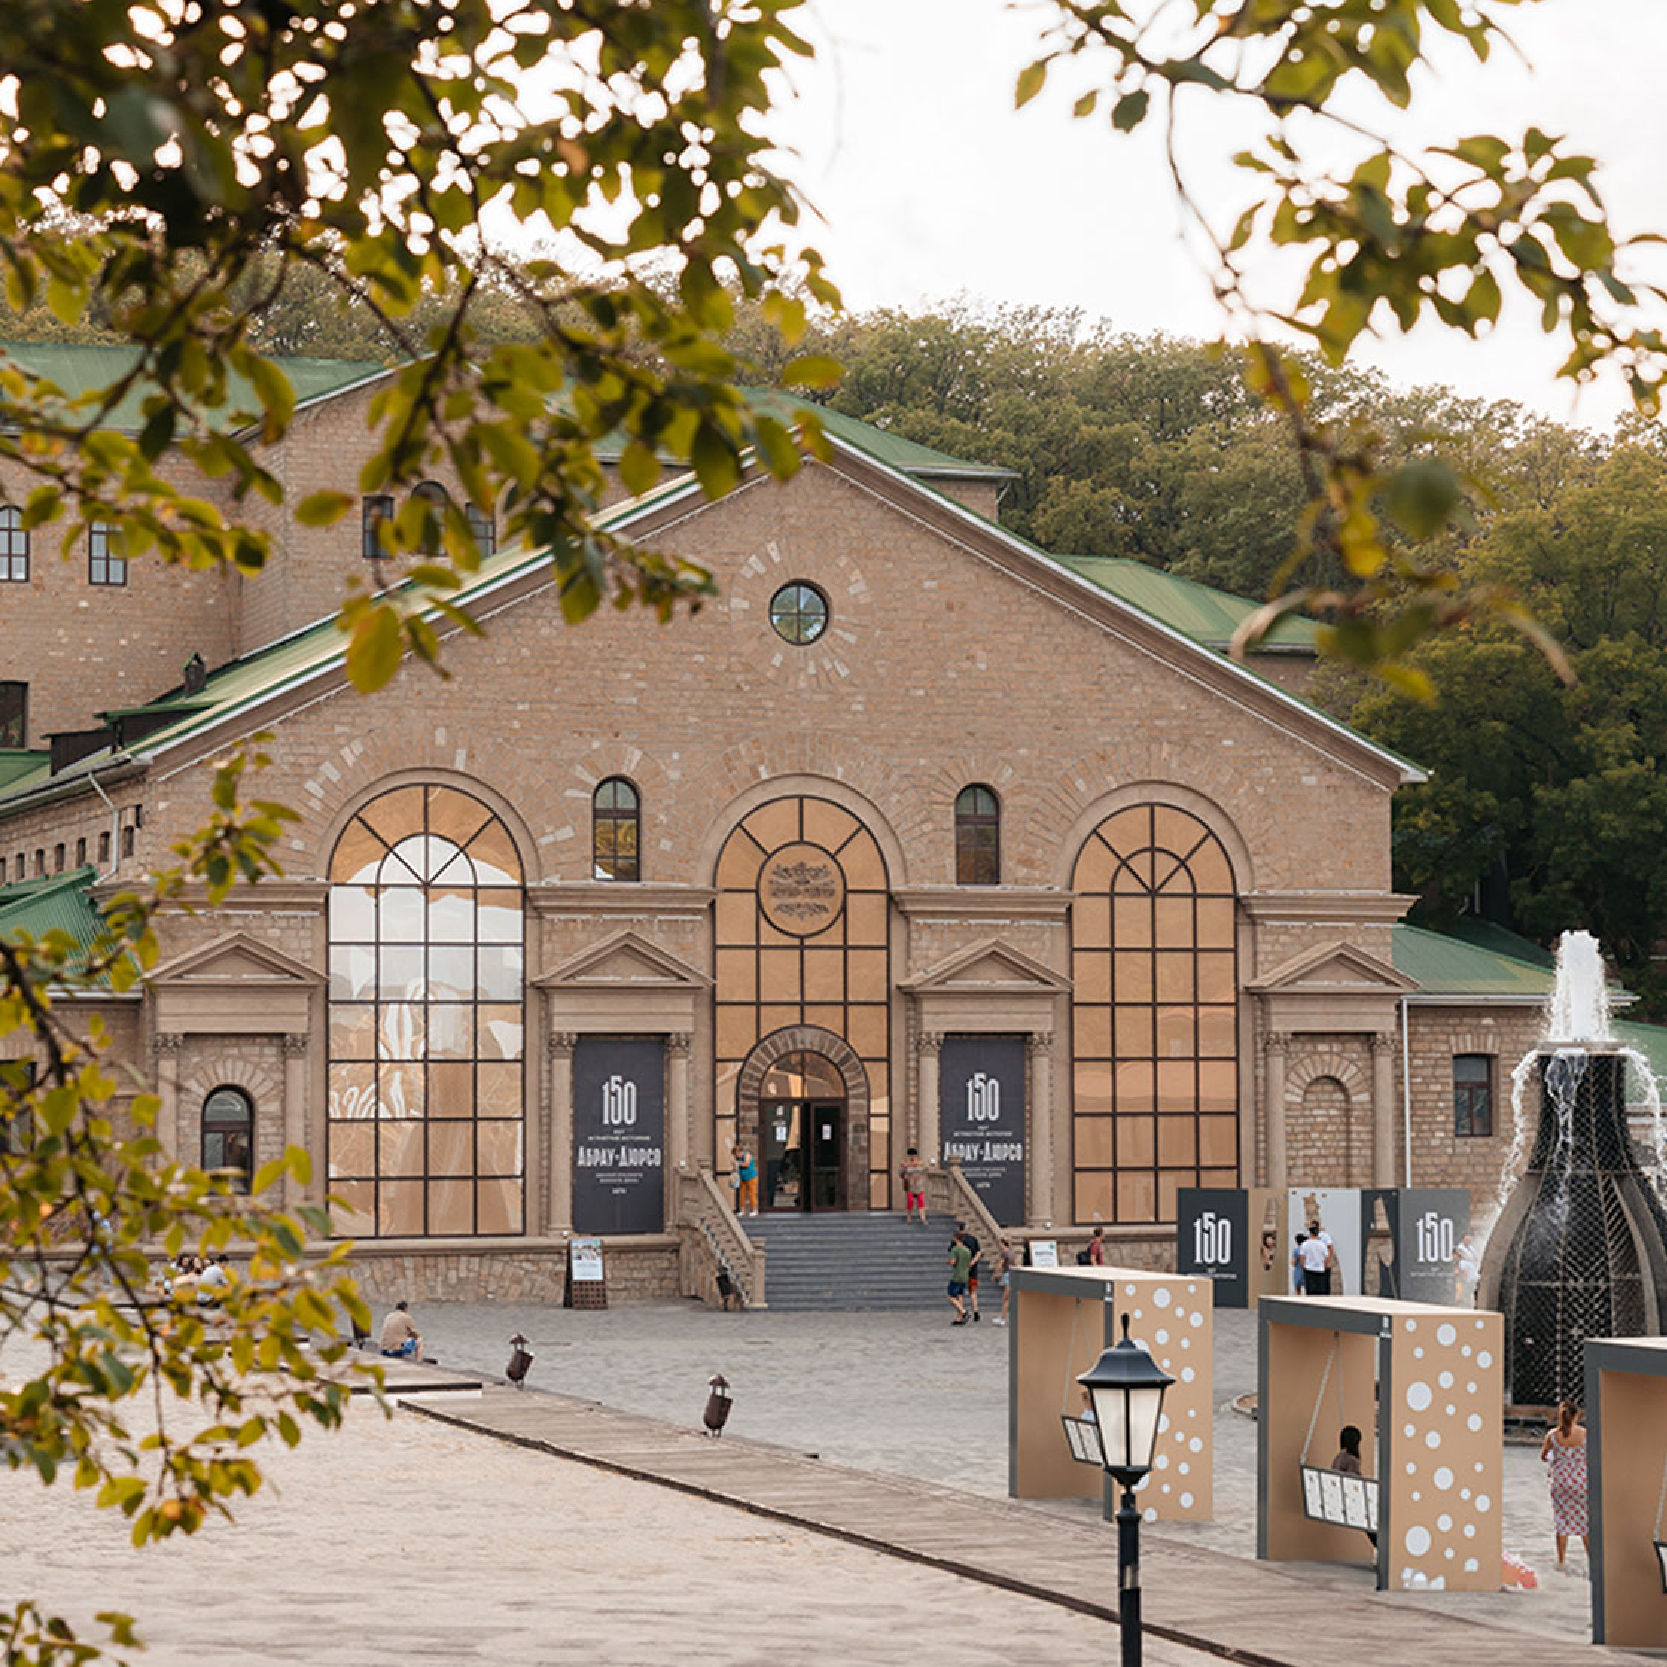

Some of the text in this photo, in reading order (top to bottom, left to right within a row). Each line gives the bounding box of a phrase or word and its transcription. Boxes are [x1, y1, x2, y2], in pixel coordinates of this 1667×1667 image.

[602, 1075, 637, 1124] 150
[966, 1072, 999, 1121] 150
[1193, 1212, 1231, 1264] 150
[1416, 1212, 1453, 1262] 150
